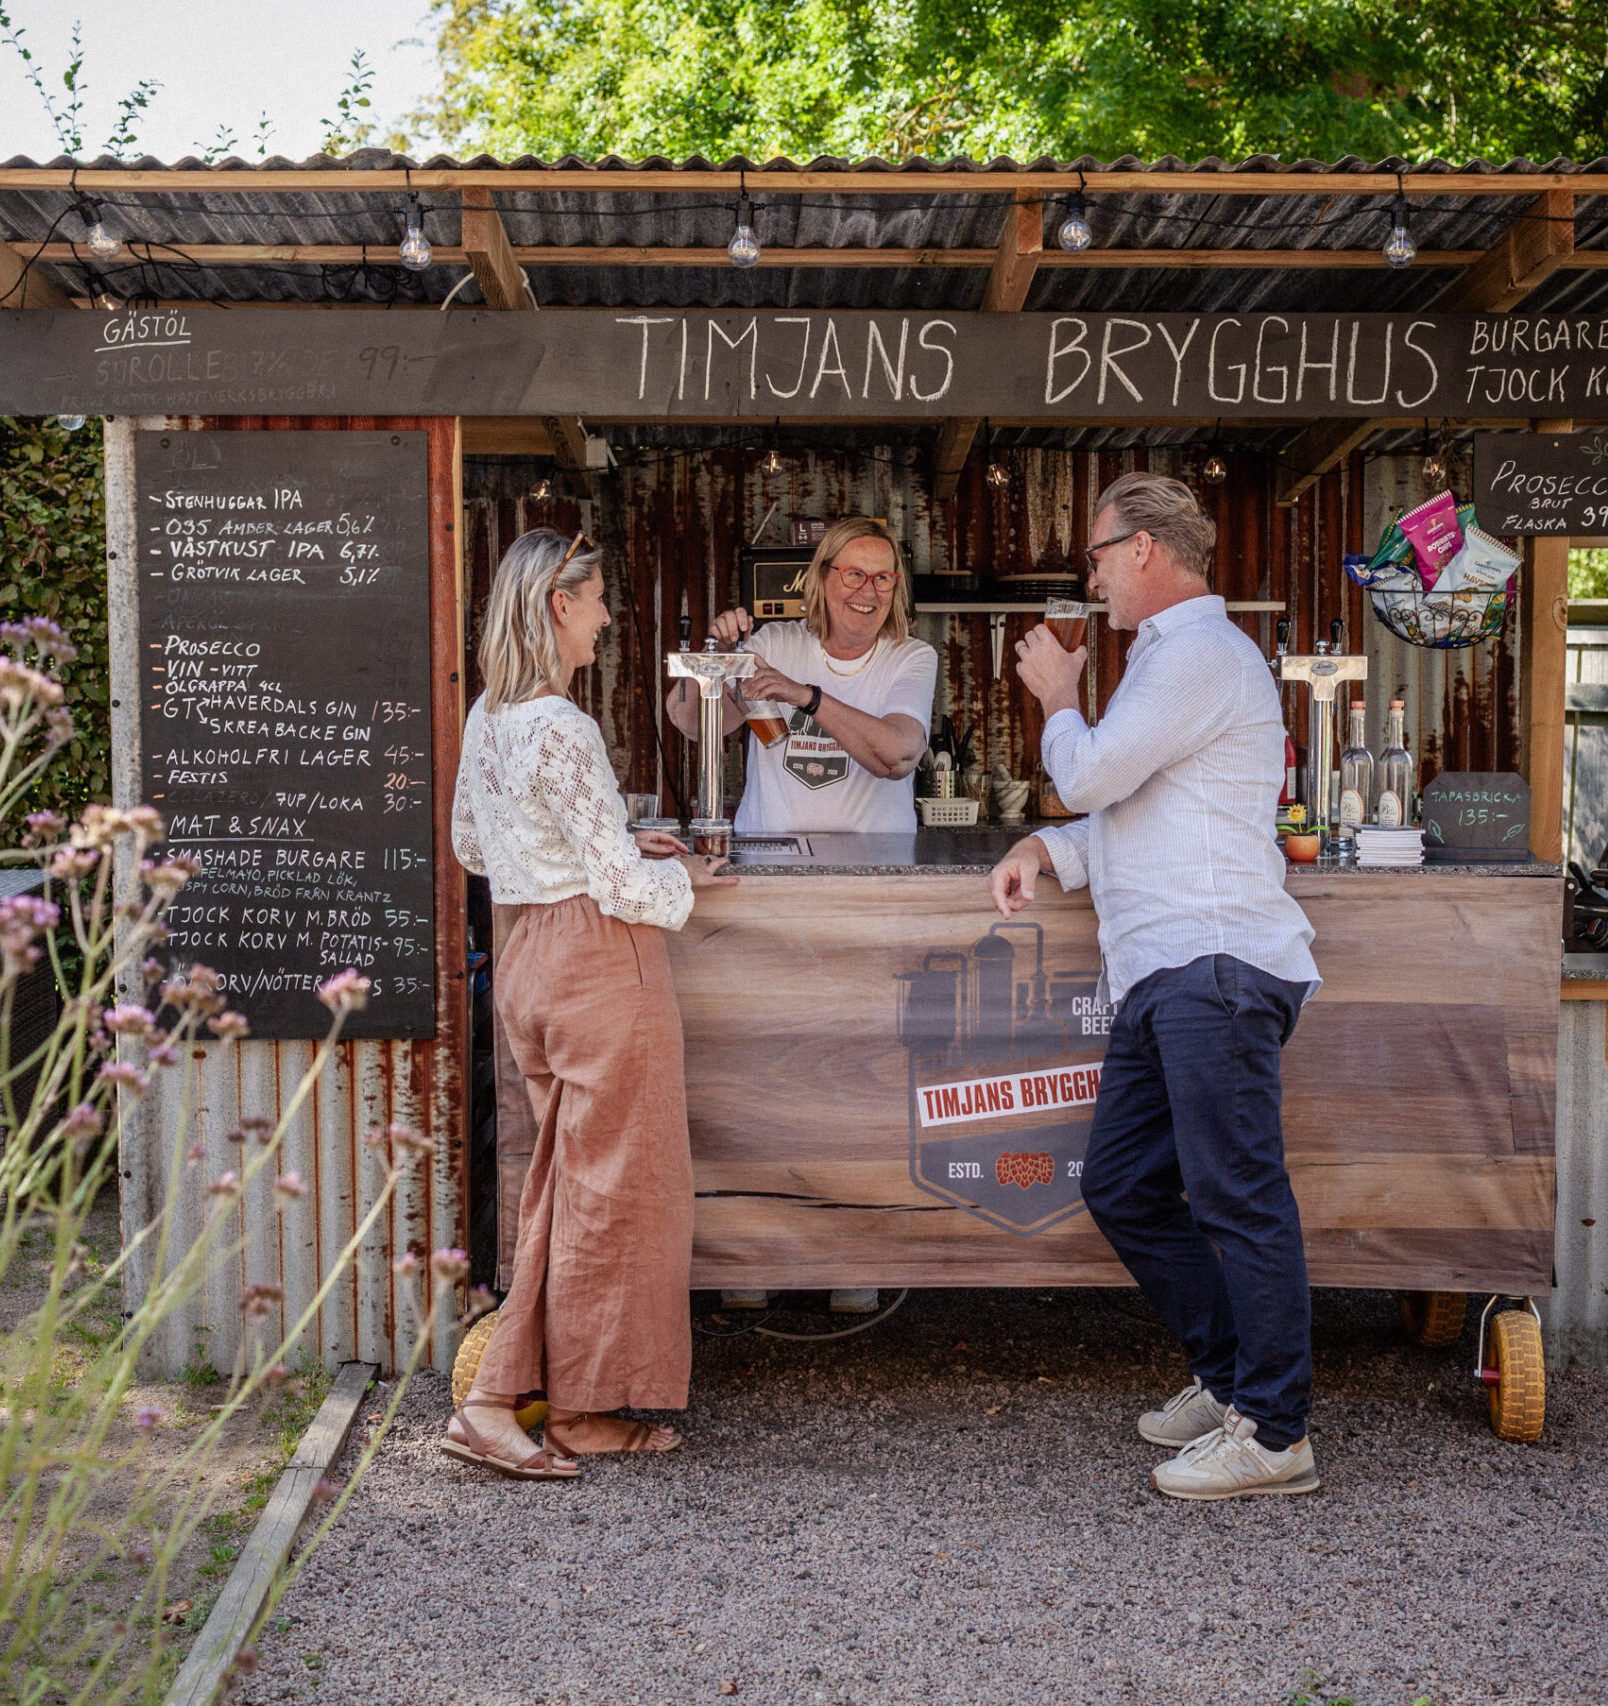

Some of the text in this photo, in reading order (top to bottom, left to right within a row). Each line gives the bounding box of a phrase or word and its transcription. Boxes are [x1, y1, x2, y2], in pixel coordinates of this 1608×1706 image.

[103, 311, 192, 344] GÄSTÖL
[1470, 318, 1608, 355] BURGARE
[615, 315, 1438, 408] TIMJANS BRYGGHUS
[1466, 364, 1570, 404] TJOCK
[165, 488, 303, 510] STENHUGGAR IPA
[1529, 497, 1574, 510] BRUT
[218, 519, 278, 536] AMBER
[283, 520, 333, 535] LAGER
[1501, 514, 1567, 530] FLASKA
[288, 540, 325, 560] IPA
[171, 559, 241, 582] GRÖTVIK
[246, 568, 306, 585] LAGER
[164, 634, 261, 657] PROSECCO
[166, 659, 204, 678] VIN
[165, 675, 247, 695] ÖLGRAPPA
[209, 695, 317, 715] HAVERDALS
[325, 701, 357, 720] GIN
[371, 700, 422, 724] 135:-
[343, 725, 371, 742] GIN
[166, 745, 425, 767] ALKOHOLFRI LAGER 45:-
[167, 769, 426, 790] FESTIS 20:-
[383, 793, 422, 815] 30:-
[168, 814, 307, 837] MAT & SNAX
[1458, 808, 1509, 826] 135:-
[275, 849, 366, 870] BURGARE
[384, 847, 427, 871] 115:-
[192, 867, 265, 884] FELMAYO,
[254, 883, 291, 899] BRÖD
[336, 889, 392, 903] KRANTZ
[167, 906, 230, 924] TJOCK
[241, 907, 297, 928] KORV
[384, 909, 429, 928] 55:-
[167, 932, 228, 948] TJOCK
[238, 932, 287, 950] KORV
[296, 931, 314, 947] M.
[393, 936, 429, 957] 95:-
[319, 949, 375, 967] SALLAD
[393, 976, 431, 995] 35:-
[1082, 1016, 1116, 1035] BEE
[923, 1068, 1103, 1120] TIMJANS BRYGGH
[948, 1161, 1084, 1179] ESTD. 20
